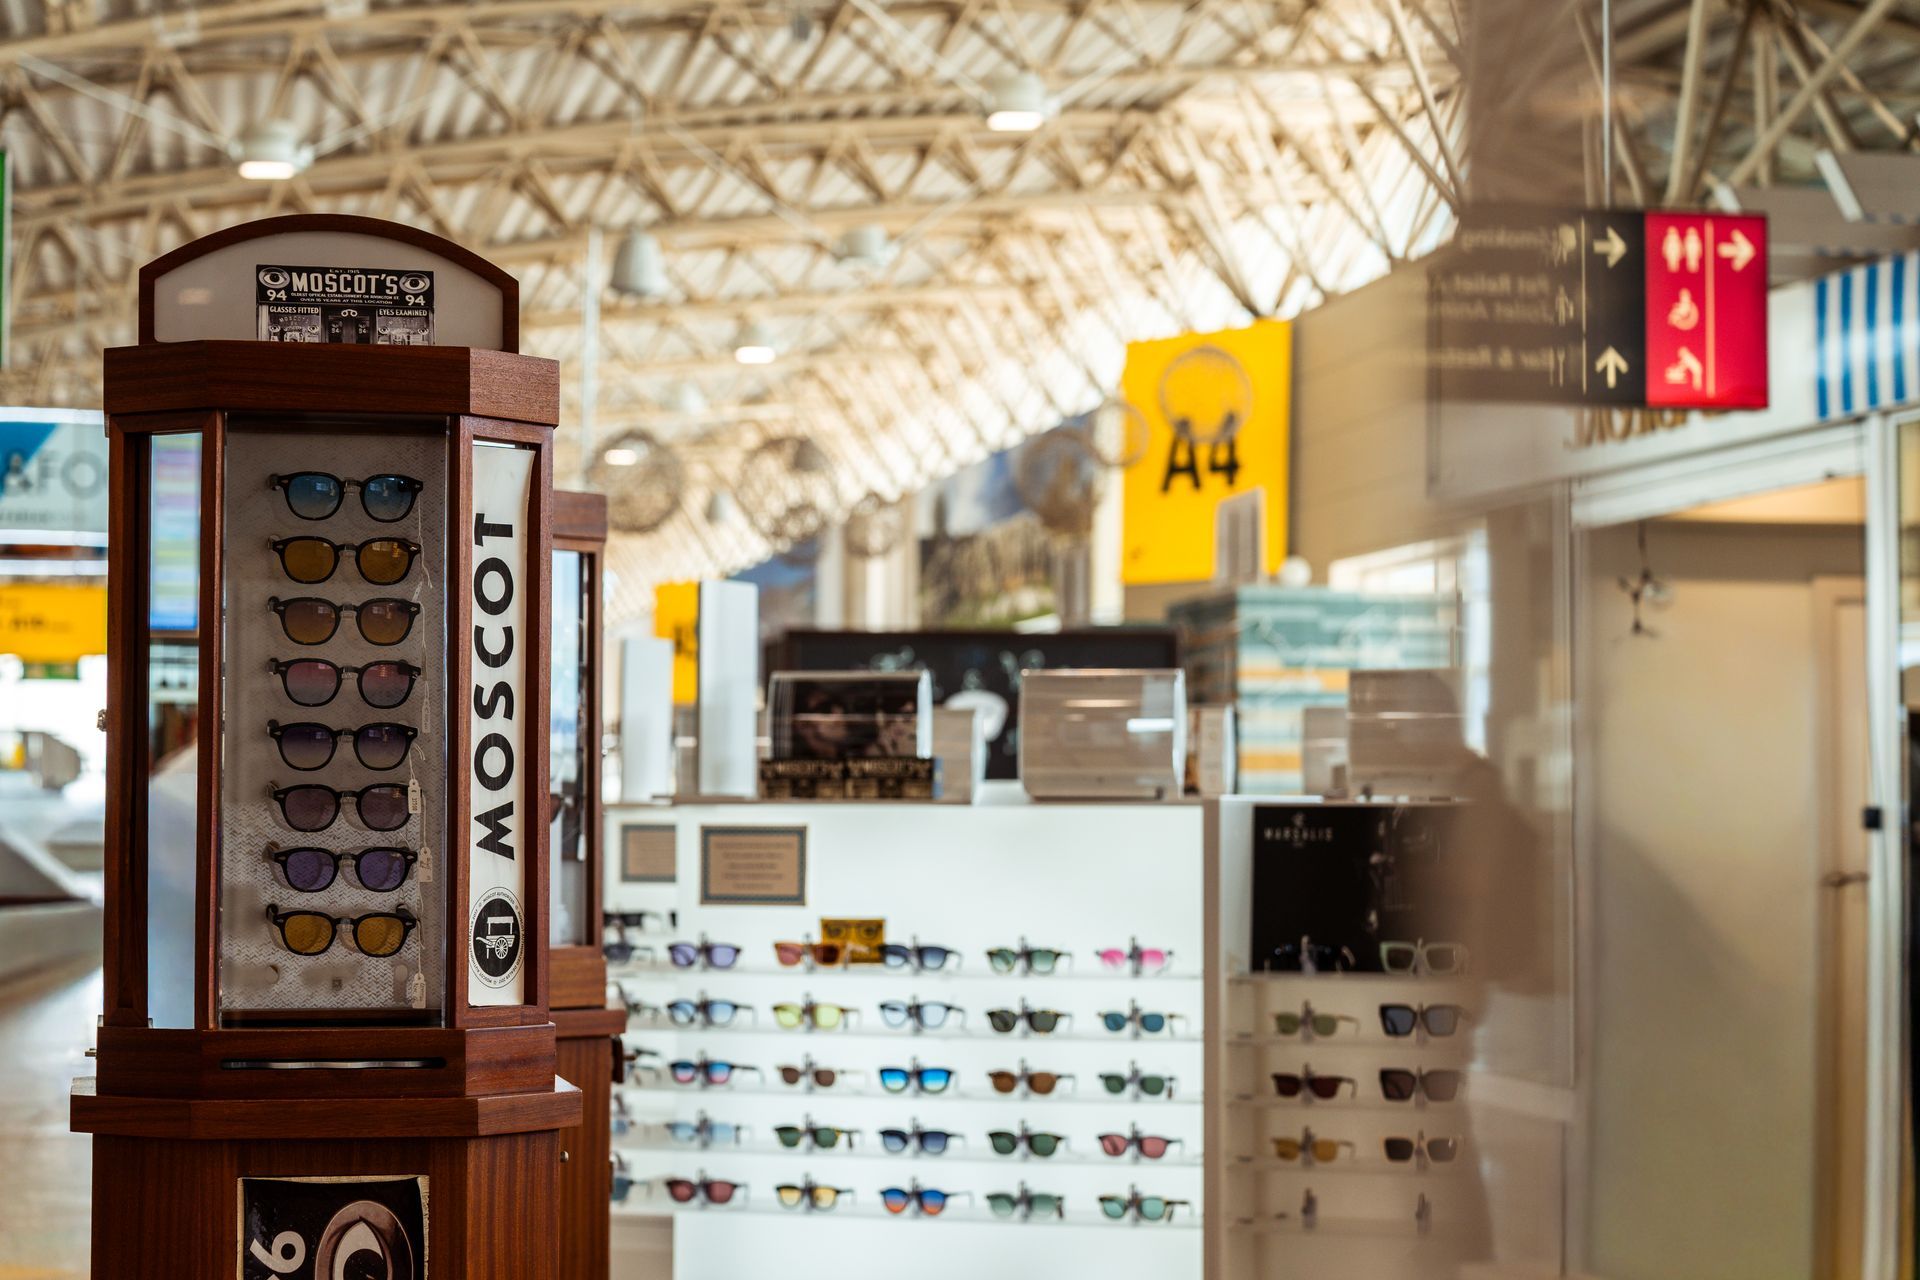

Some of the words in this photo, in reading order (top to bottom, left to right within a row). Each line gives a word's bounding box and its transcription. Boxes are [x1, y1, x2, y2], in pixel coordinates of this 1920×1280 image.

[291, 272, 398, 295] MOSCOT'S
[266, 289, 287, 301] 94
[405, 294, 426, 306] 94
[269, 305, 296, 314] GLASSES
[297, 306, 319, 314] FITTED
[379, 308, 394, 316] EYES
[395, 309, 428, 317] EXAMINED
[1161, 412, 1241, 493] A4
[474, 513, 515, 861] MOSCOT
